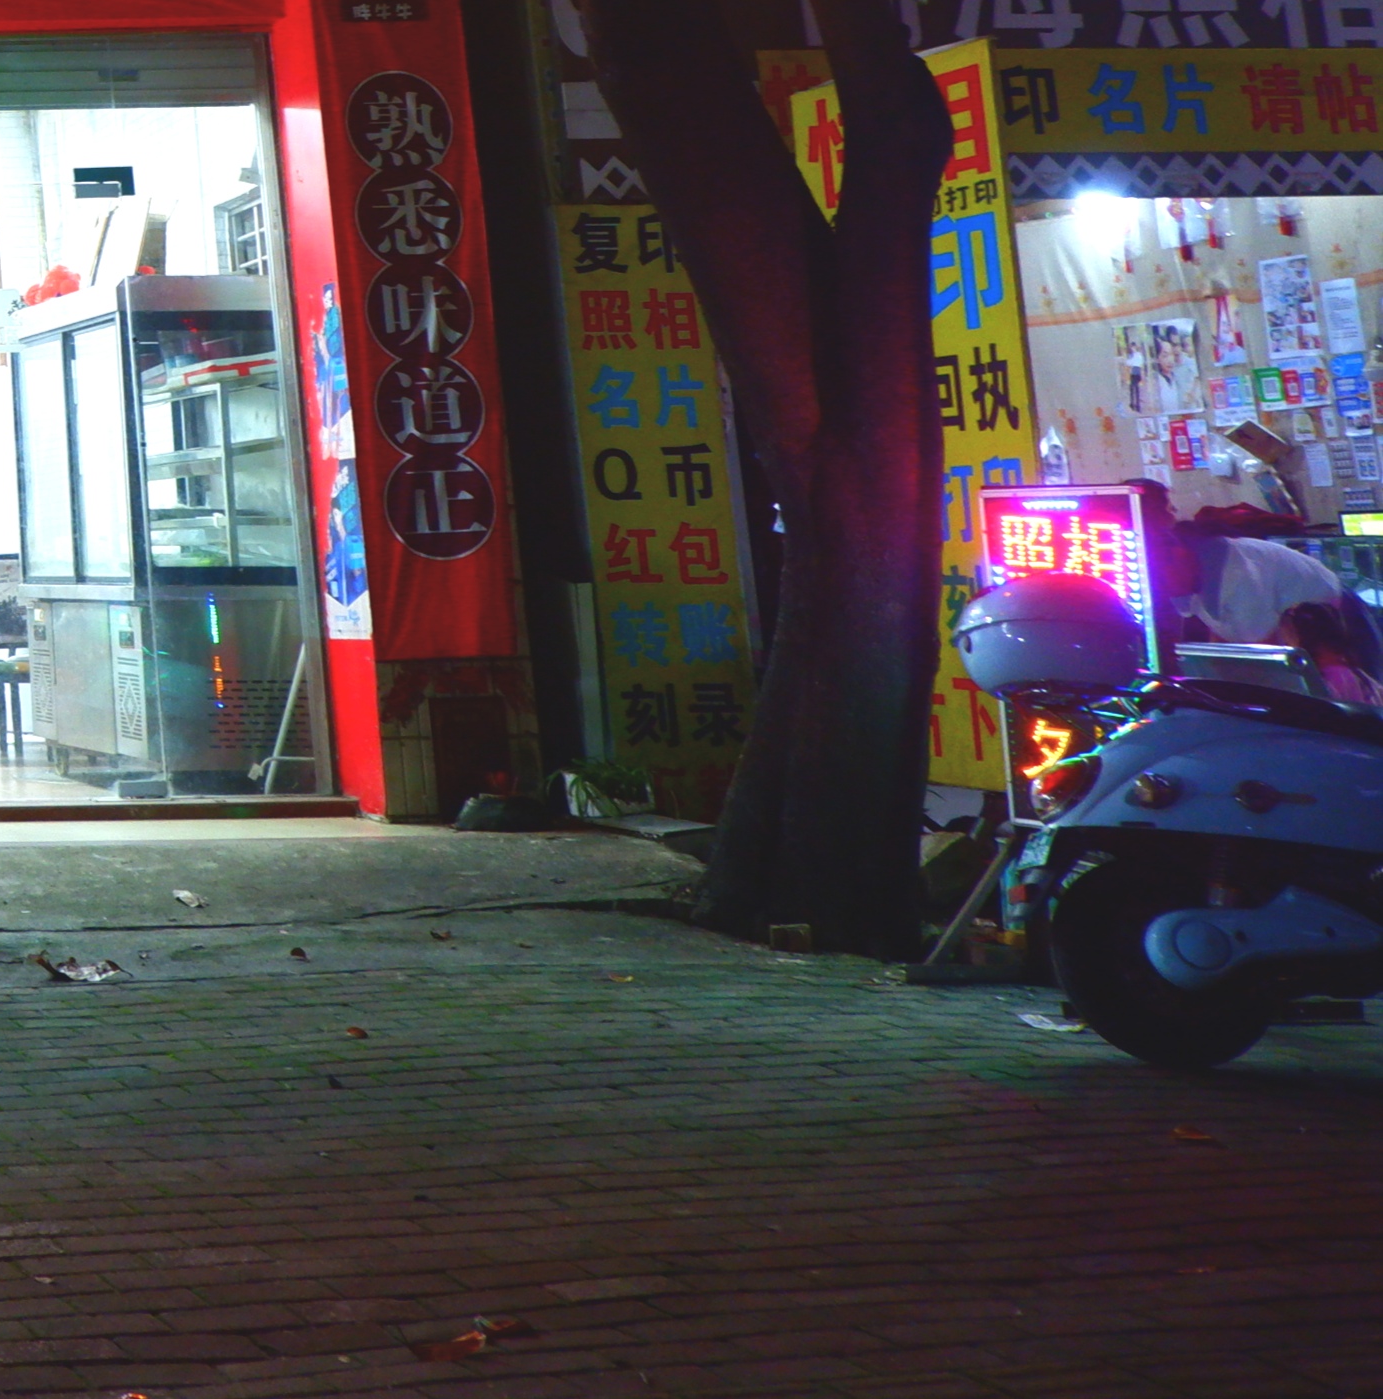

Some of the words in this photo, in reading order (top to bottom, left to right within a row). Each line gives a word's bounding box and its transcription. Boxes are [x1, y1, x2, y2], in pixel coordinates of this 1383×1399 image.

[1088, 62, 1214, 136] 名片
[1242, 62, 1379, 137] 请帖
[571, 211, 681, 275] 复印
[363, 90, 487, 535] 熟悉味道正
[580, 287, 703, 352] 照相
[587, 364, 705, 430] 名片
[593, 443, 715, 507] Q币
[603, 521, 730, 587] 红包
[1000, 514, 1128, 577] 照相
